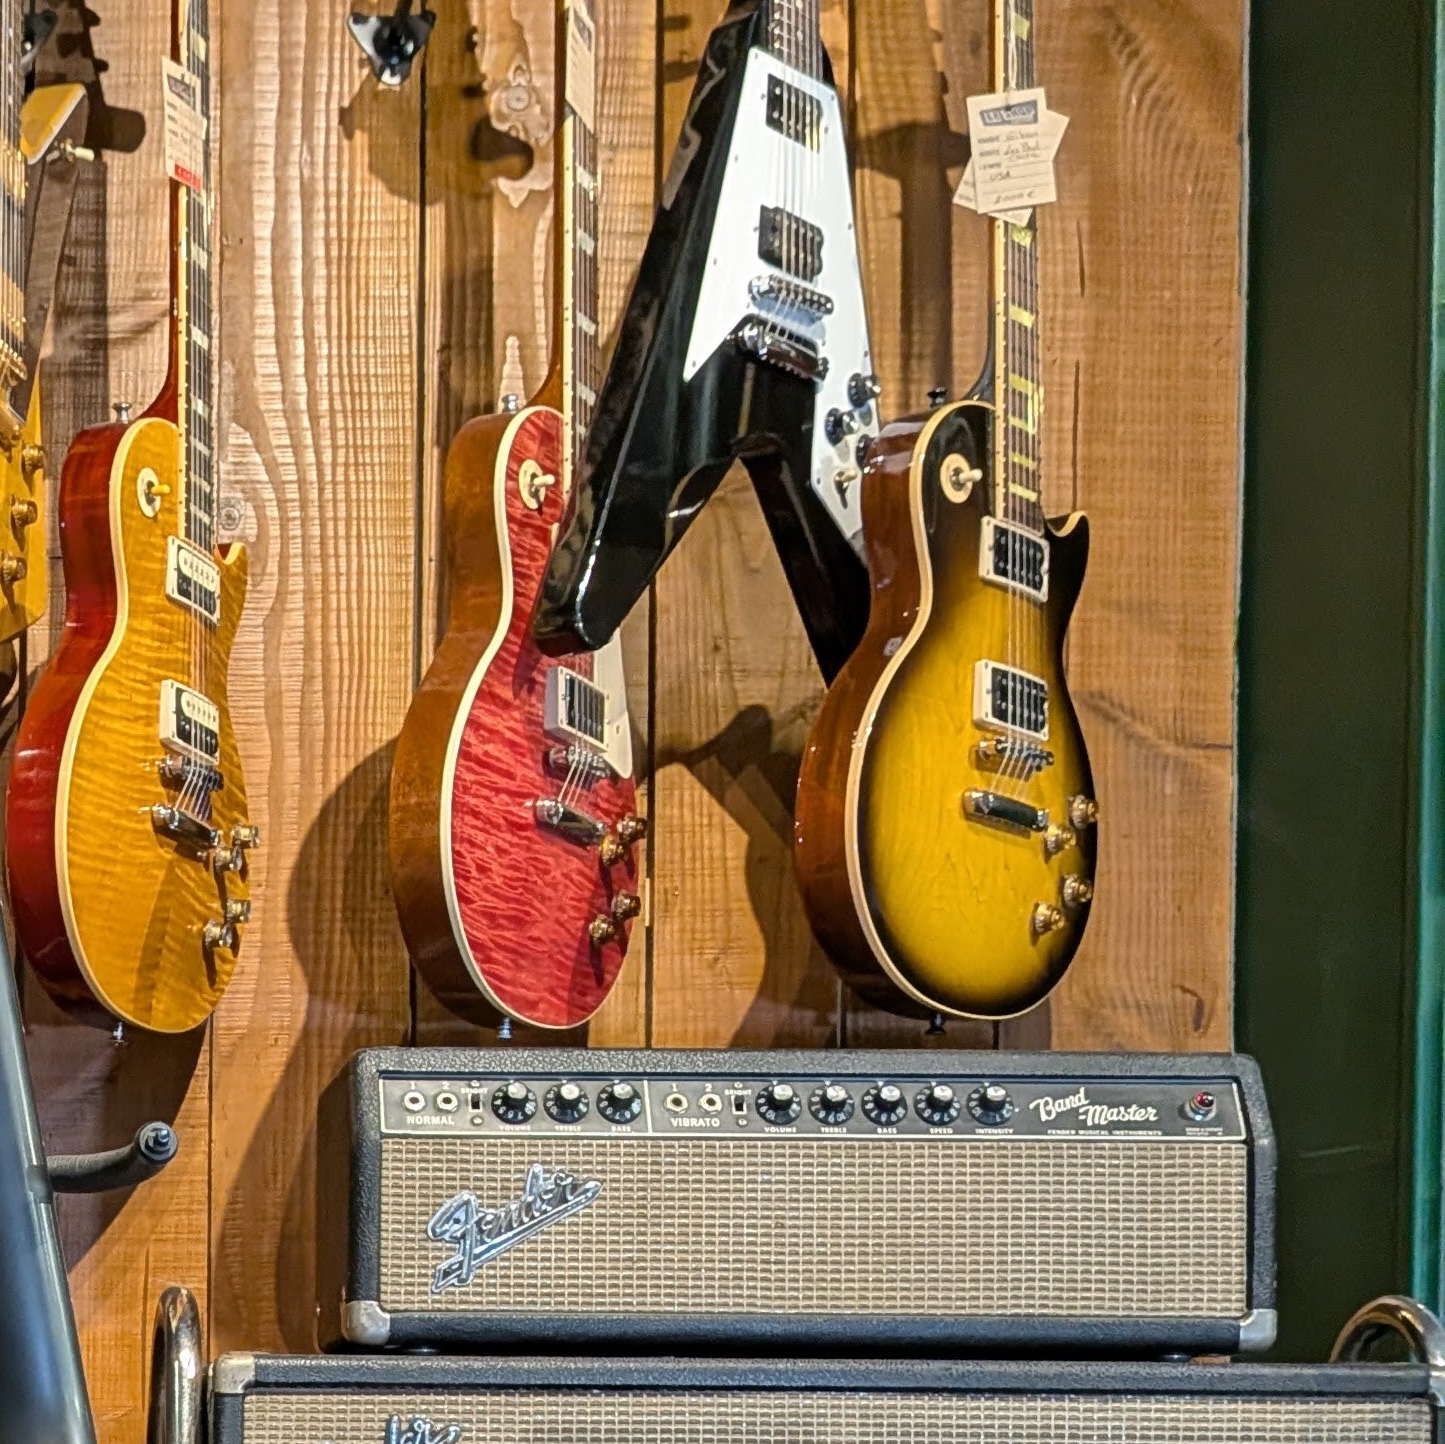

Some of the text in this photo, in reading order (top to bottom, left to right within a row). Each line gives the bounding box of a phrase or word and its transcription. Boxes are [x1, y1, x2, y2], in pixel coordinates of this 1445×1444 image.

[1029, 1086, 1090, 1121] Band
[407, 1115, 455, 1125] NORMAL
[671, 1117, 720, 1127] VIBRATO
[427, 1163, 603, 1293] Fender
